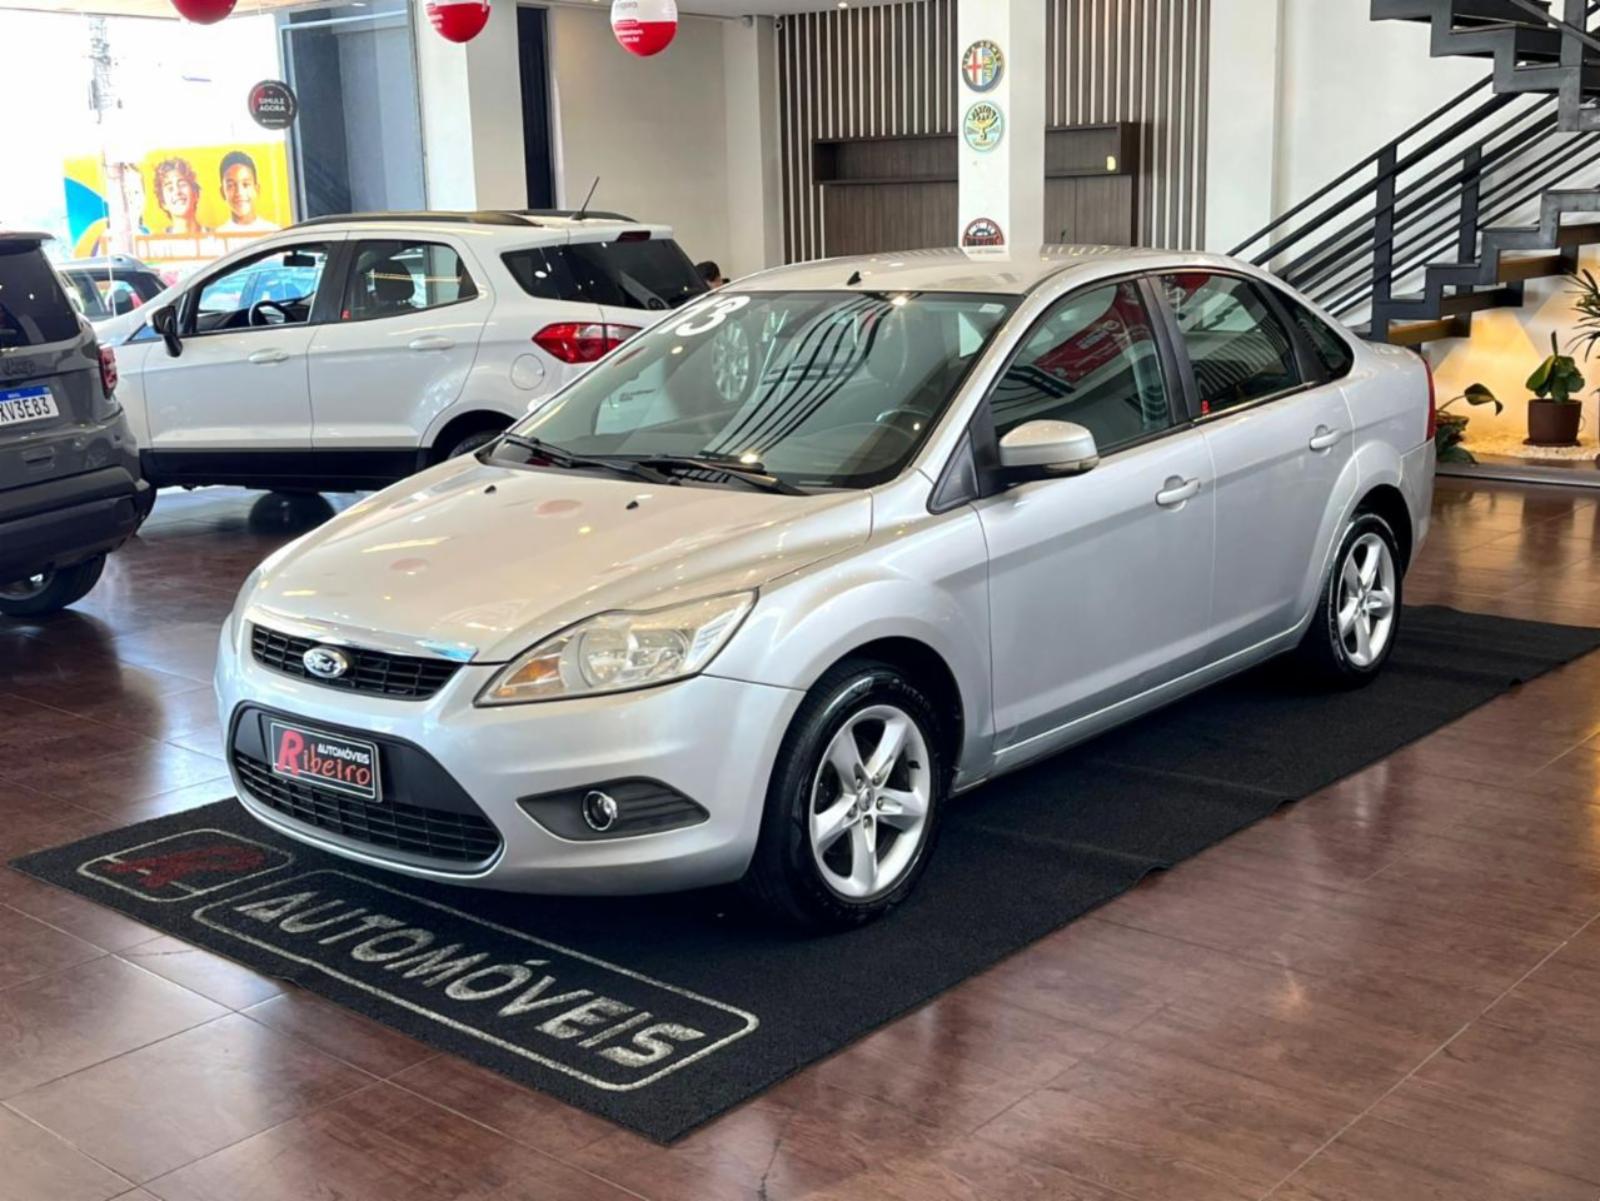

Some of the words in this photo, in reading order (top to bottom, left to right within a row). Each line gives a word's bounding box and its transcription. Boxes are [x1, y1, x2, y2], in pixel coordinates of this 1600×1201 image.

[277, 730, 371, 786] Ribeiro
[316, 743, 370, 765] AUTOMÓVEIS
[233, 891, 706, 1067] AUTOMÓVEIS
